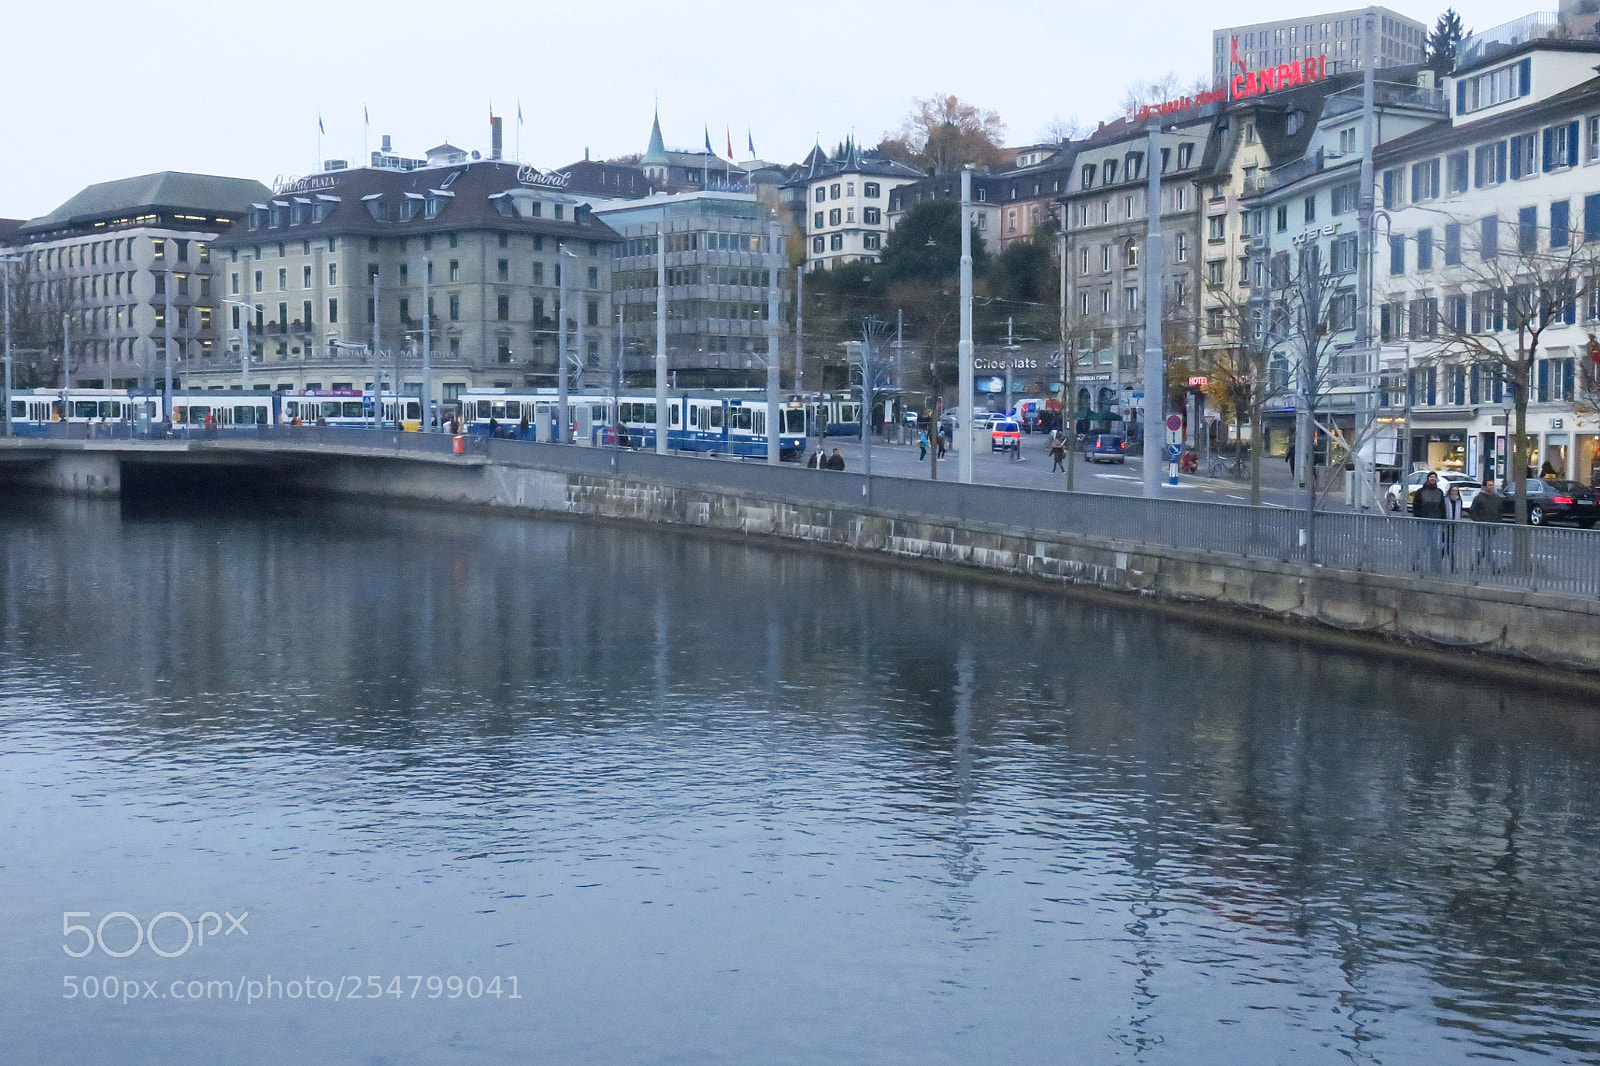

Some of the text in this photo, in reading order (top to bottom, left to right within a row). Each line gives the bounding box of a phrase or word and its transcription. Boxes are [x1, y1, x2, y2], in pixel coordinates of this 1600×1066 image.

[1231, 54, 1326, 99] CAMPARI
[517, 162, 571, 187] Central
[311, 177, 335, 188] PLAZA
[337, 348, 393, 359] RESTAURNT
[1188, 376, 1208, 386] HOTEL
